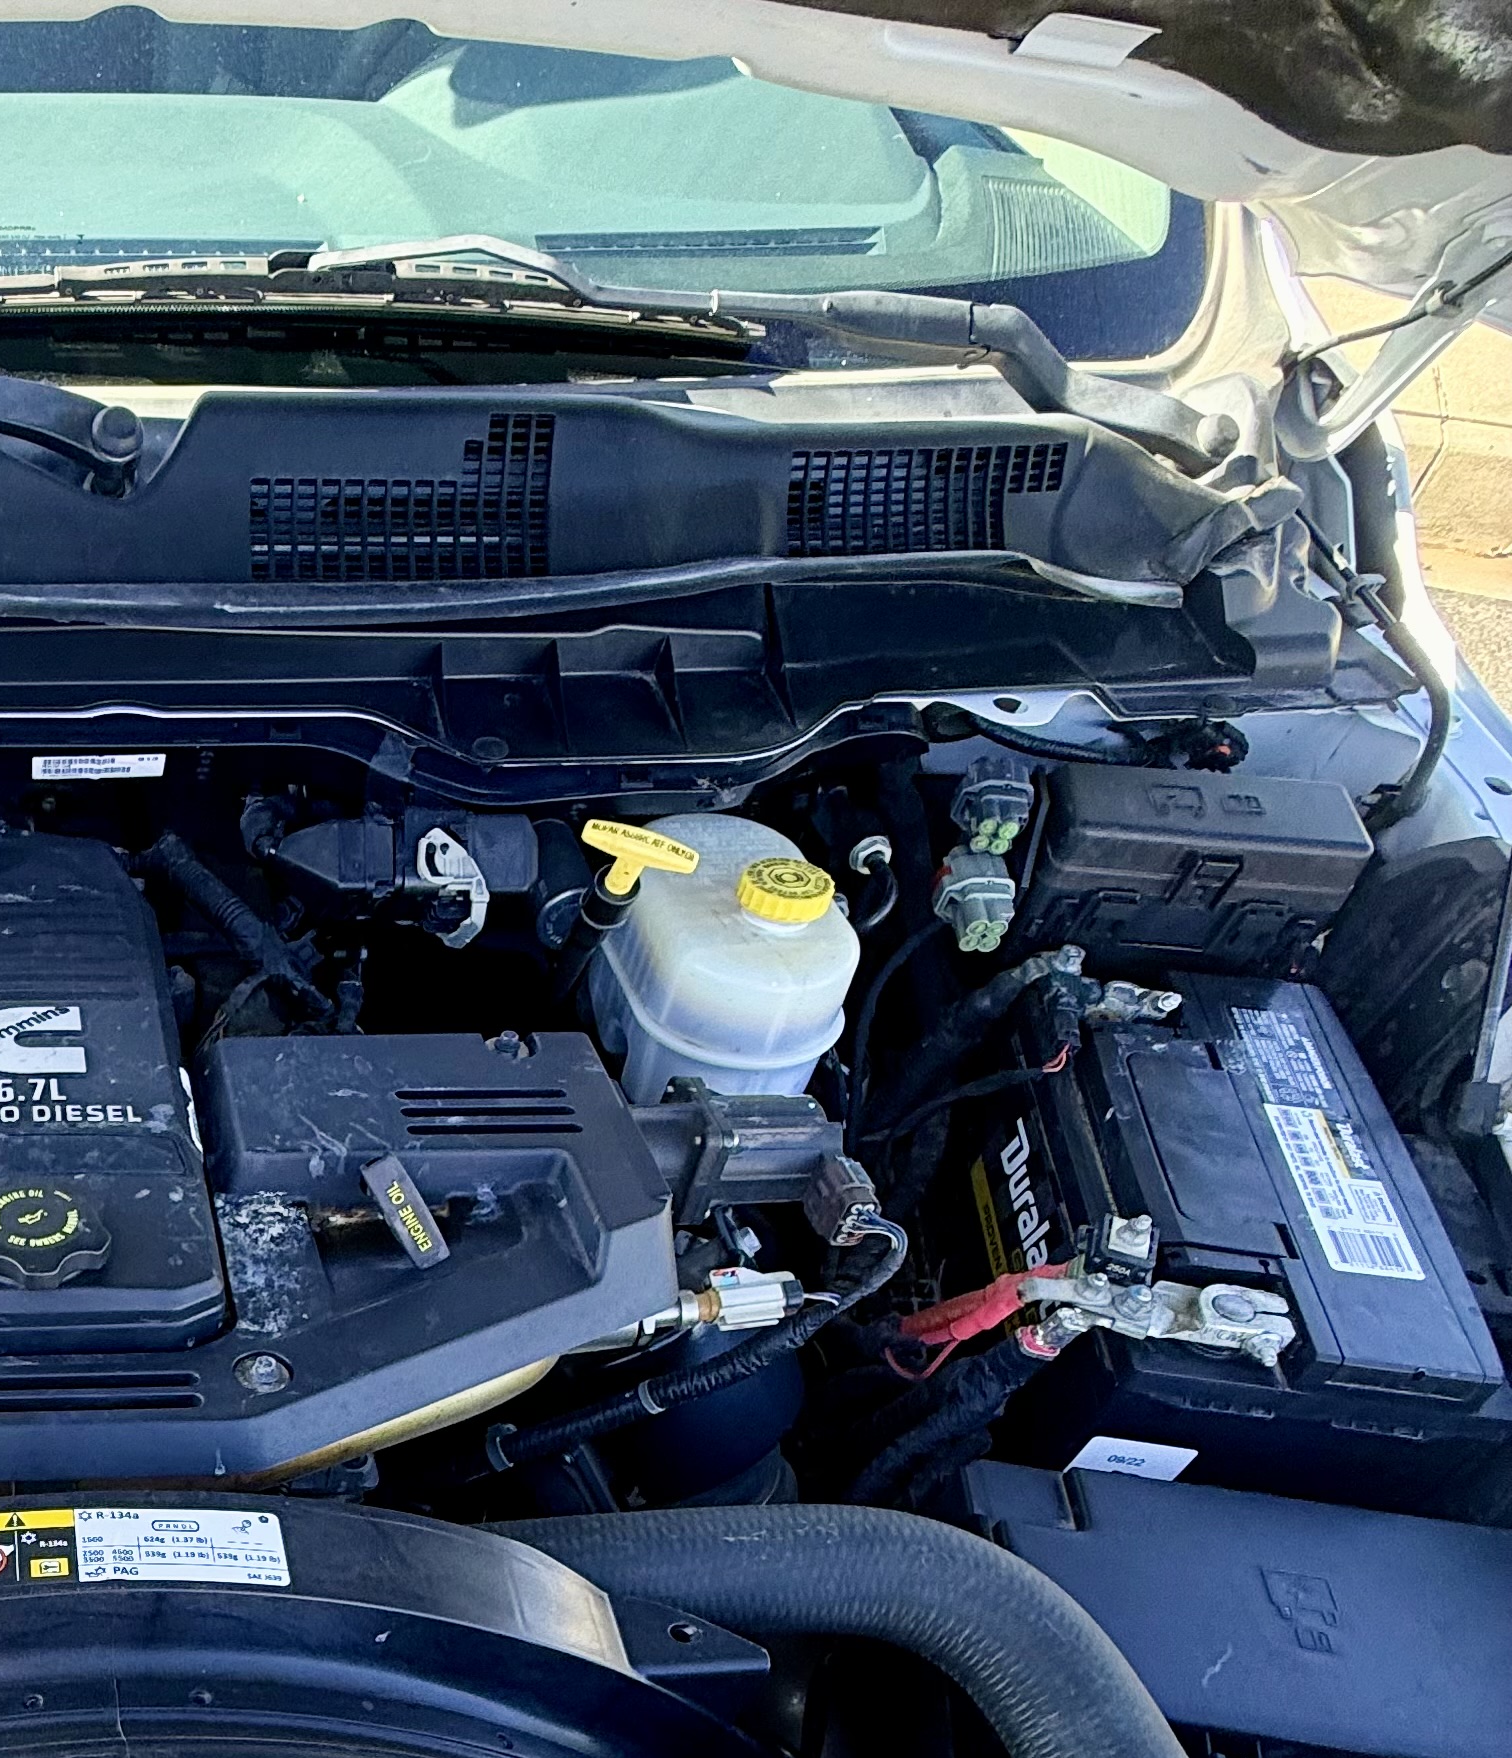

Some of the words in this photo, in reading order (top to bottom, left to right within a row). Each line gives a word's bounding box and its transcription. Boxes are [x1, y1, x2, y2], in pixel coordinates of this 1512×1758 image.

[32, 1105, 143, 1123] DIESEL
[28, 1189, 44, 1198] OIL
[386, 1180, 405, 1205] OIL
[1000, 1116, 1060, 1320] Durala
[398, 1204, 433, 1253] ENGINE
[7, 1234, 27, 1247] SEE
[1105, 1263, 1131, 1277] 250A
[1107, 1454, 1146, 1467] 09/22
[96, 1511, 140, 1520] R-134a
[113, 1566, 139, 1576] PAG
